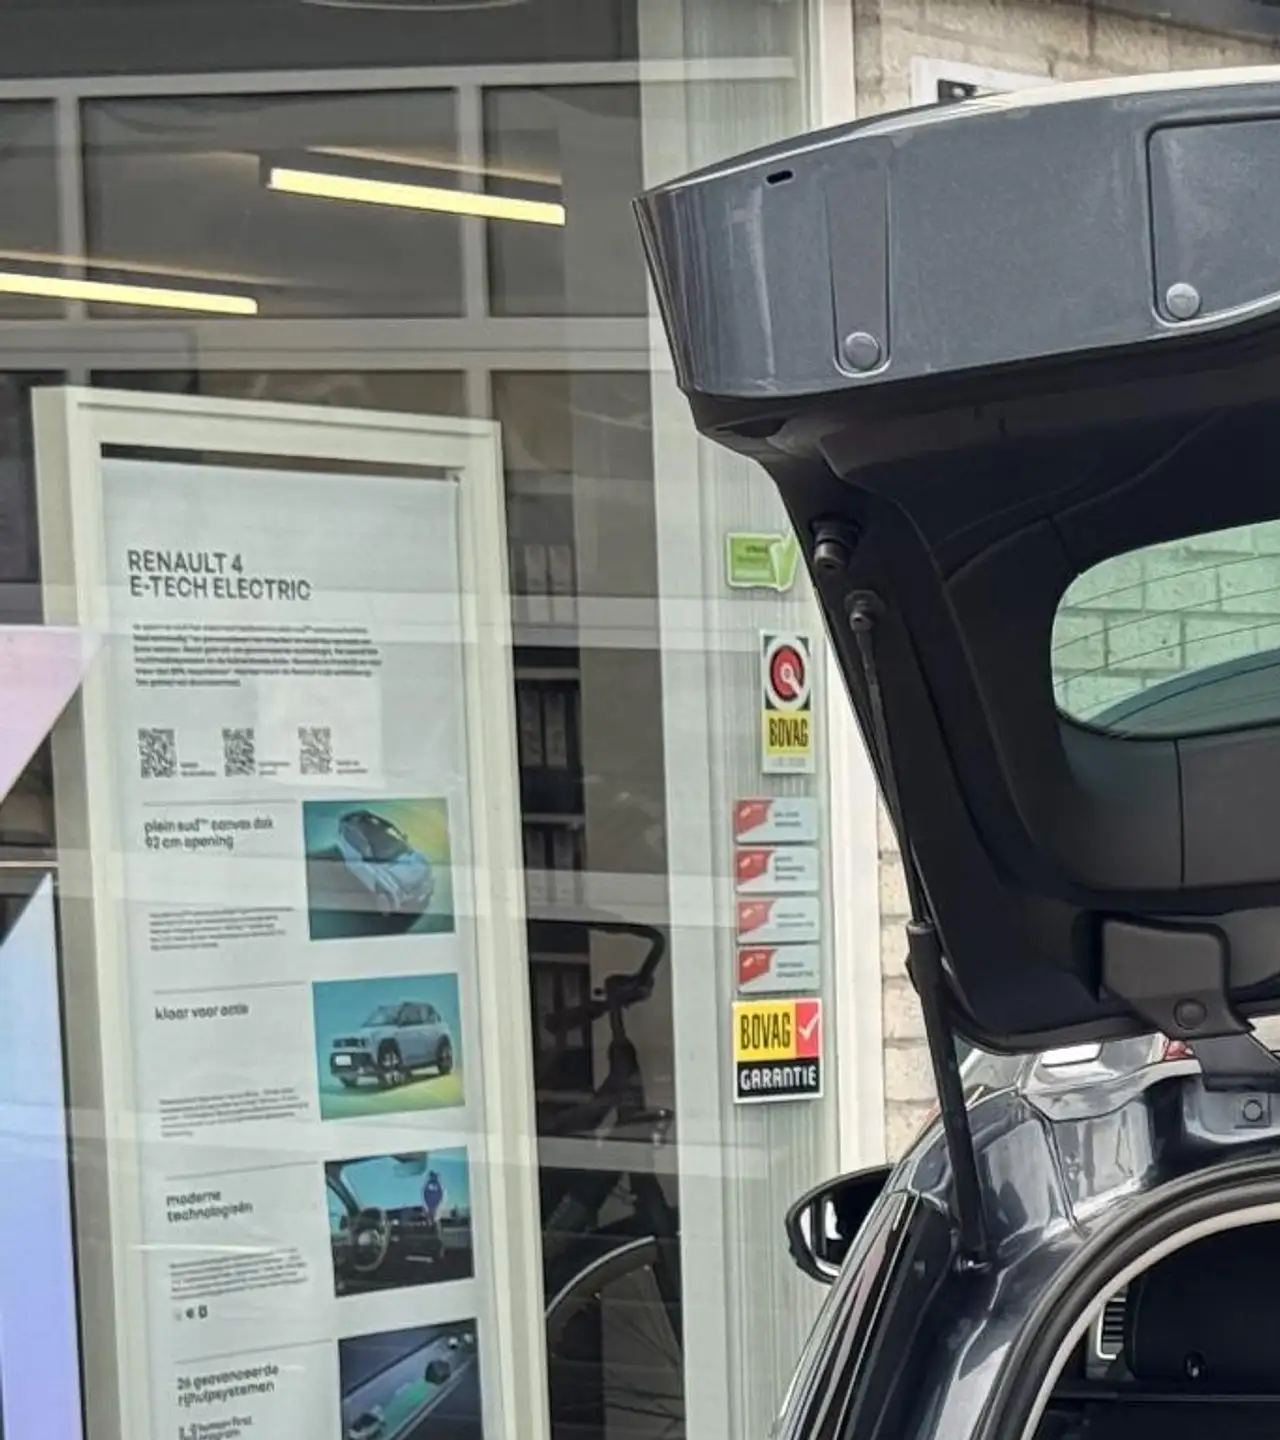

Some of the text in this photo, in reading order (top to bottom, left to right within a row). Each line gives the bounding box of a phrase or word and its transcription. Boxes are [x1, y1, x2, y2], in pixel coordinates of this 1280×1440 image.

[127, 550, 243, 575] RENAULT 4
[130, 575, 312, 601] E-TECH ELECTRIC
[769, 717, 809, 748] BOVAG
[740, 1012, 790, 1051] BOVAG
[740, 1064, 817, 1091] GARANTIE
